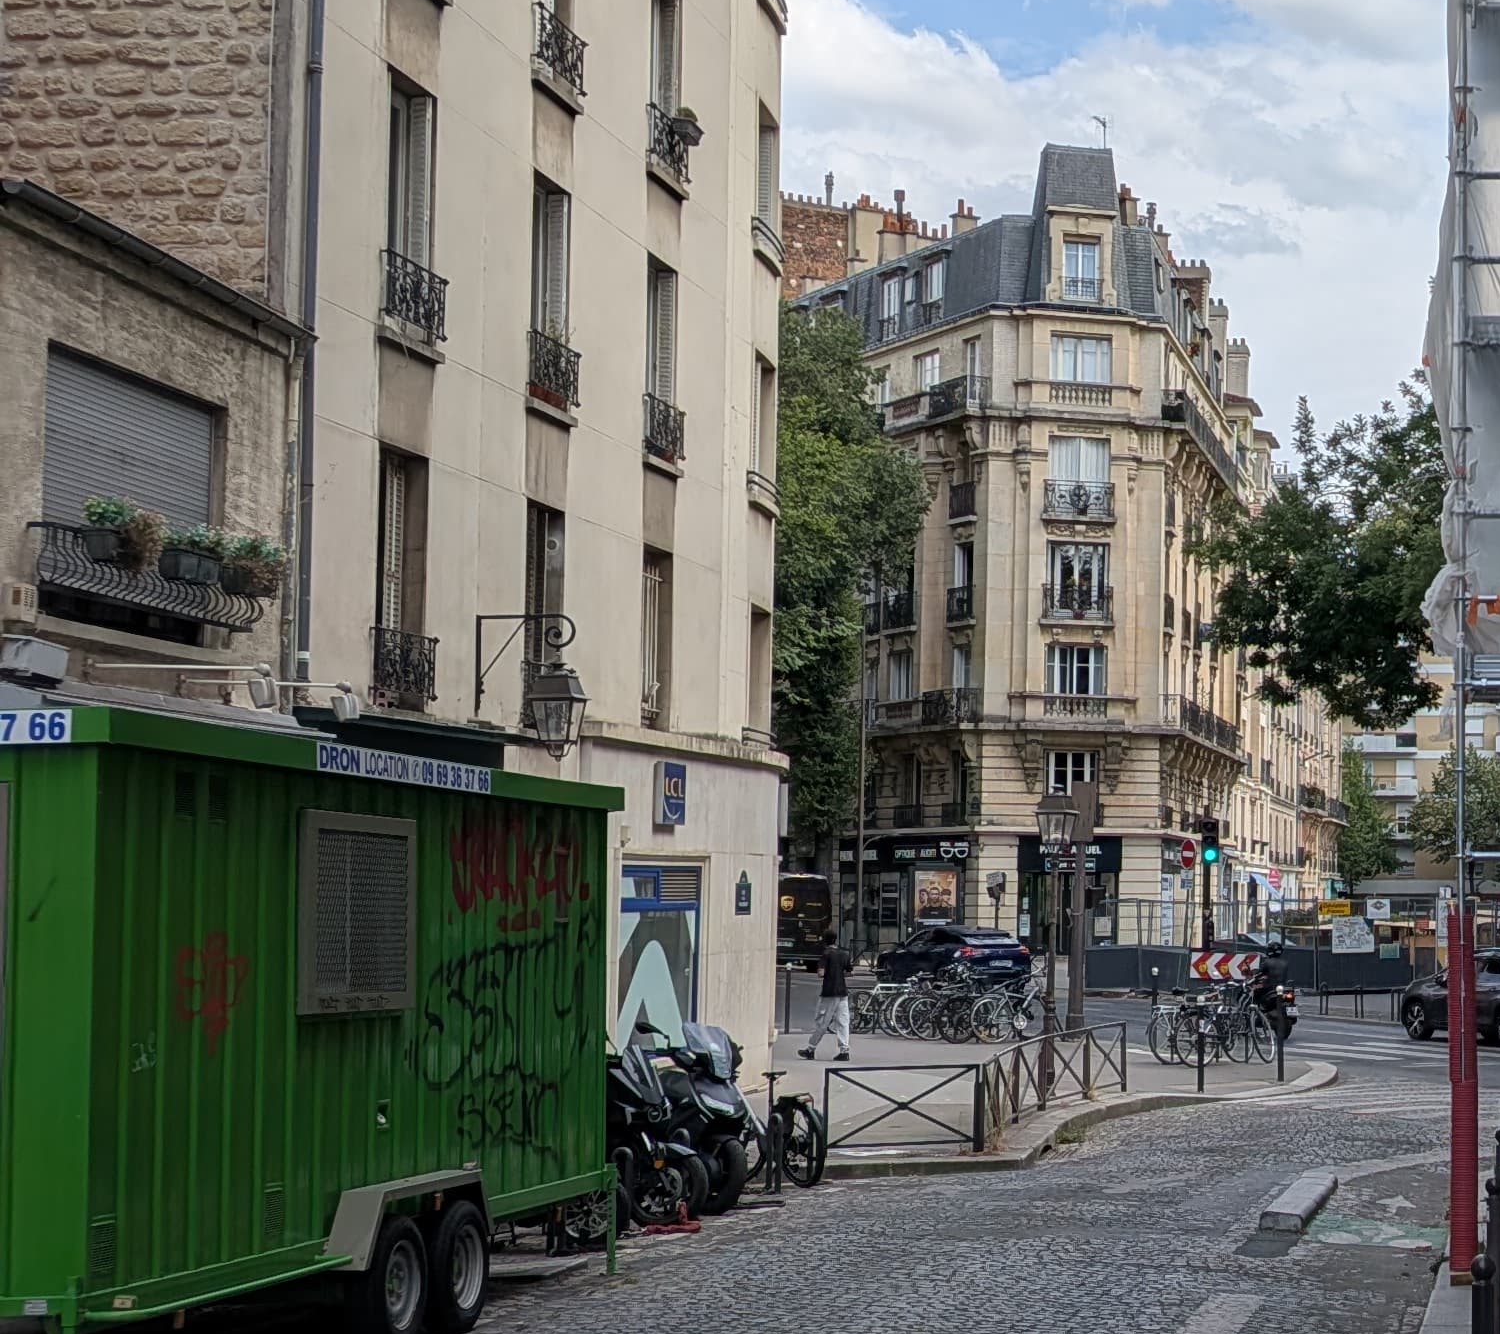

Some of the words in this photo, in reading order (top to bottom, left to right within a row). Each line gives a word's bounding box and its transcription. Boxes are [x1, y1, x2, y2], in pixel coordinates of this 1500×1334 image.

[28, 711, 66, 741] 66
[319, 744, 361, 774] DRON
[364, 751, 409, 781] LOCATION
[421, 760, 434, 784] 09
[436, 763, 449, 787] 69
[450, 765, 463, 788] 36
[464, 767, 476, 790] 37
[477, 770, 490, 792] 66
[665, 777, 685, 798] LCL
